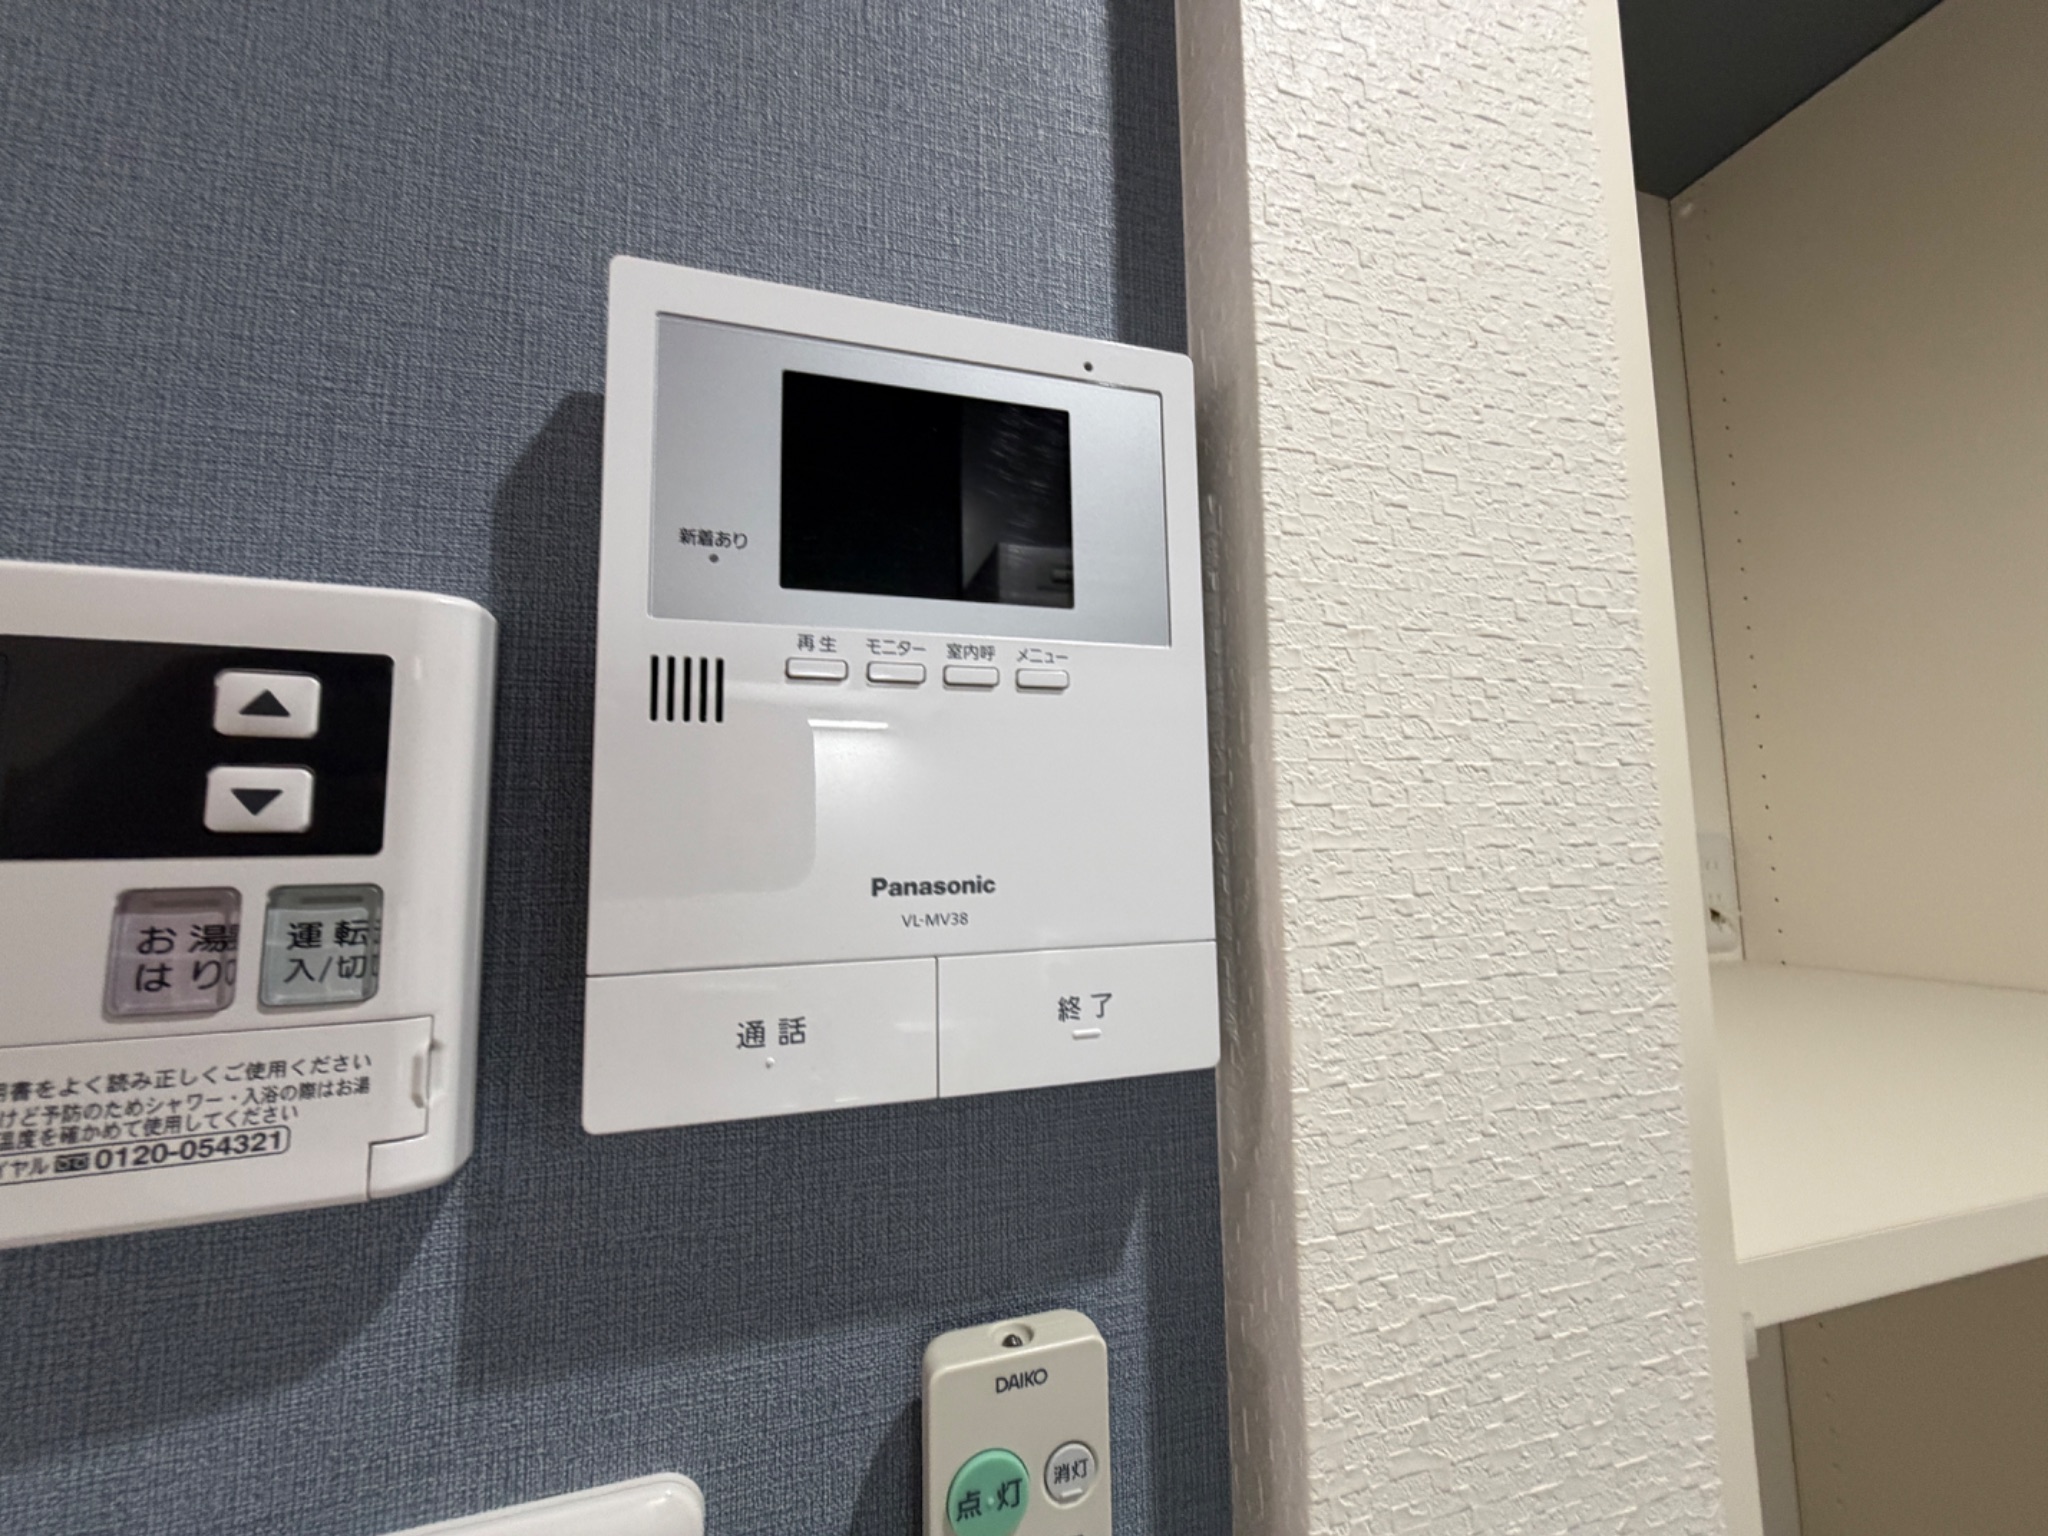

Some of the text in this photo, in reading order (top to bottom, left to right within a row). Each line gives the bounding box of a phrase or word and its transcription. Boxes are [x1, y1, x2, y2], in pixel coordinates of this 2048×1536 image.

[679, 527, 748, 549] 新着あり
[797, 633, 837, 653] 再生
[866, 637, 926, 656] モニター
[946, 643, 996, 661] 室内呼
[1016, 648, 1069, 664] メニュー
[871, 875, 996, 898] Panasonic
[901, 912, 969, 928] VL-MV38
[137, 923, 228, 955] お湯
[288, 919, 369, 950] 運転
[135, 959, 222, 992] はり
[284, 955, 367, 983] 入/切
[1057, 993, 1113, 1023] 終了
[736, 1016, 807, 1050] 通話
[94, 1132, 281, 1170] 0120-054321
[996, 1368, 1048, 1393] DAIKO
[1053, 1458, 1088, 1484] 消灯
[956, 1478, 1023, 1522] 点灯
